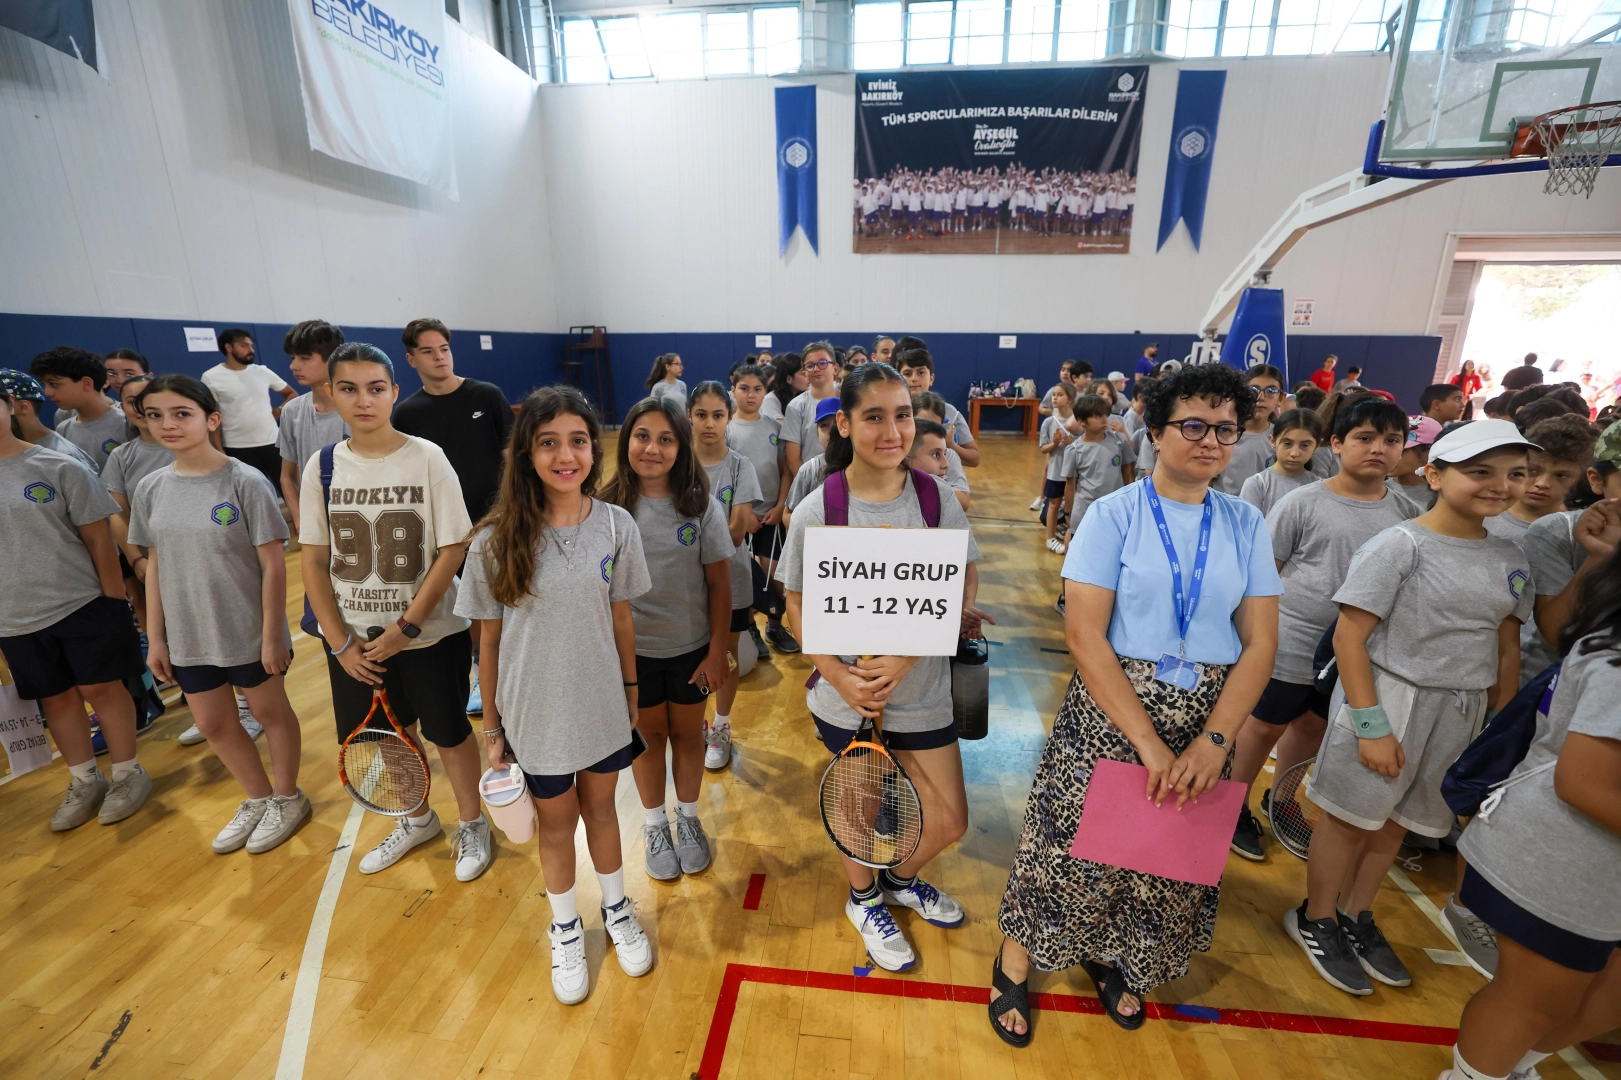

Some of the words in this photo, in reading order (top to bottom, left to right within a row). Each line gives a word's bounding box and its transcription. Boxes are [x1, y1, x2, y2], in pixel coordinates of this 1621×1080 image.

[868, 79, 897, 91] EVİMİZ
[861, 89, 903, 101] BAKIRKÖY
[881, 113, 906, 126] TÜM
[907, 106, 1006, 123] SPORCULARIMIZA
[1007, 106, 1070, 119] BAŞARILAR
[1071, 107, 1118, 122] DİLERİM
[973, 126, 1019, 141] AYŞEGÜL
[1249, 340, 1267, 367] S
[330, 509, 425, 584] 98
[817, 556, 886, 580] SİYAH
[893, 562, 959, 582] GRUP
[351, 587, 399, 600] VARSITY
[343, 599, 408, 613] CHAMPIONS
[824, 596, 850, 614] 11
[872, 597, 898, 615] 12
[905, 597, 948, 620] YAŞ
[9, 740, 27, 753] GRUP
[26, 734, 47, 749] BEYAZ
